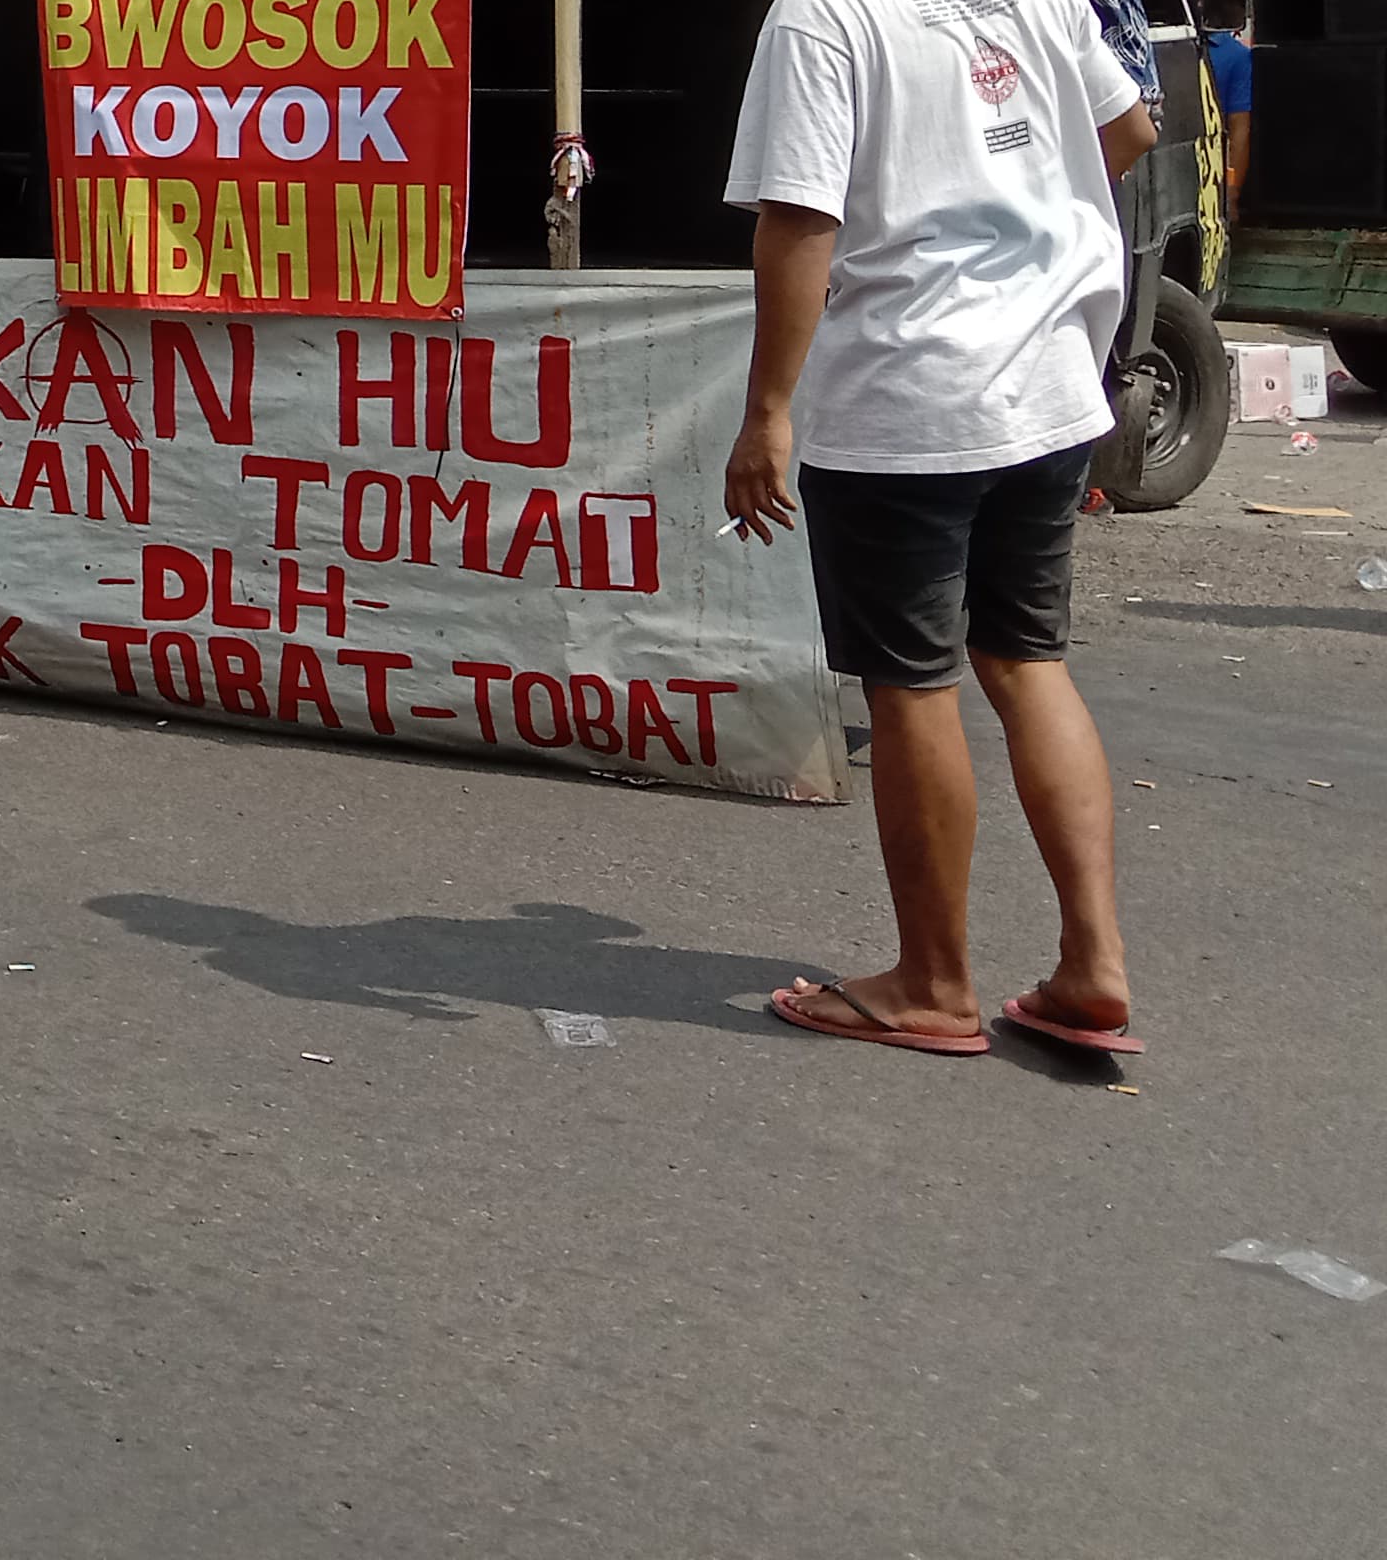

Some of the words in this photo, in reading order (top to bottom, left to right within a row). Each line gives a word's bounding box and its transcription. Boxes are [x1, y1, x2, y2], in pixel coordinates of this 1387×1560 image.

[73, 84, 409, 162] KOYOK
[56, 177, 310, 301] LIMBAH
[335, 182, 453, 307] MU
[337, 327, 572, 469] HIU
[241, 454, 659, 593] TOMAT
[79, 623, 740, 768] TOBAT-TOBAT
